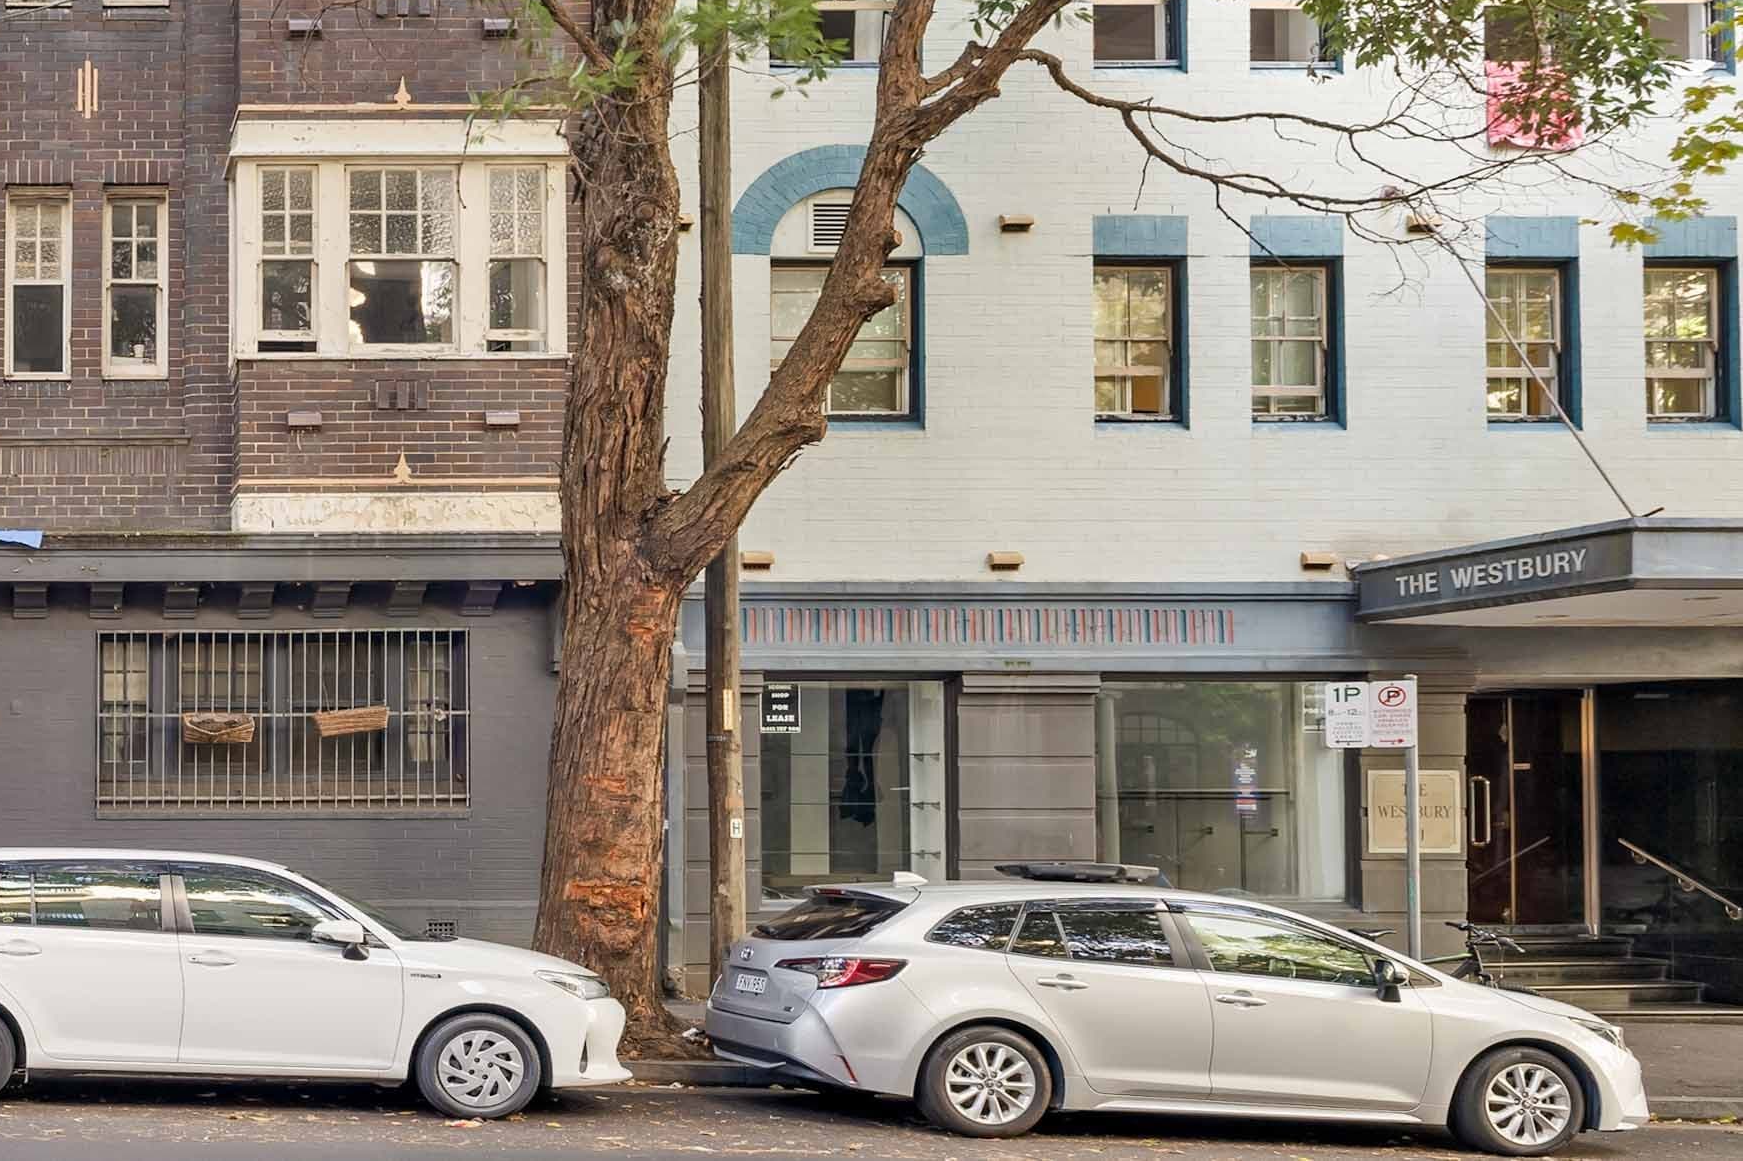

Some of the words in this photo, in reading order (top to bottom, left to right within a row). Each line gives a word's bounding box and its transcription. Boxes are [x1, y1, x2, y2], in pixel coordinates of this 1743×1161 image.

[1395, 572, 1439, 596] THE
[1450, 548, 1587, 589] WESTBURY
[1332, 687, 1361, 703] 1P
[1402, 783, 1427, 797] TE
[1377, 805, 1452, 819] WESBURY
